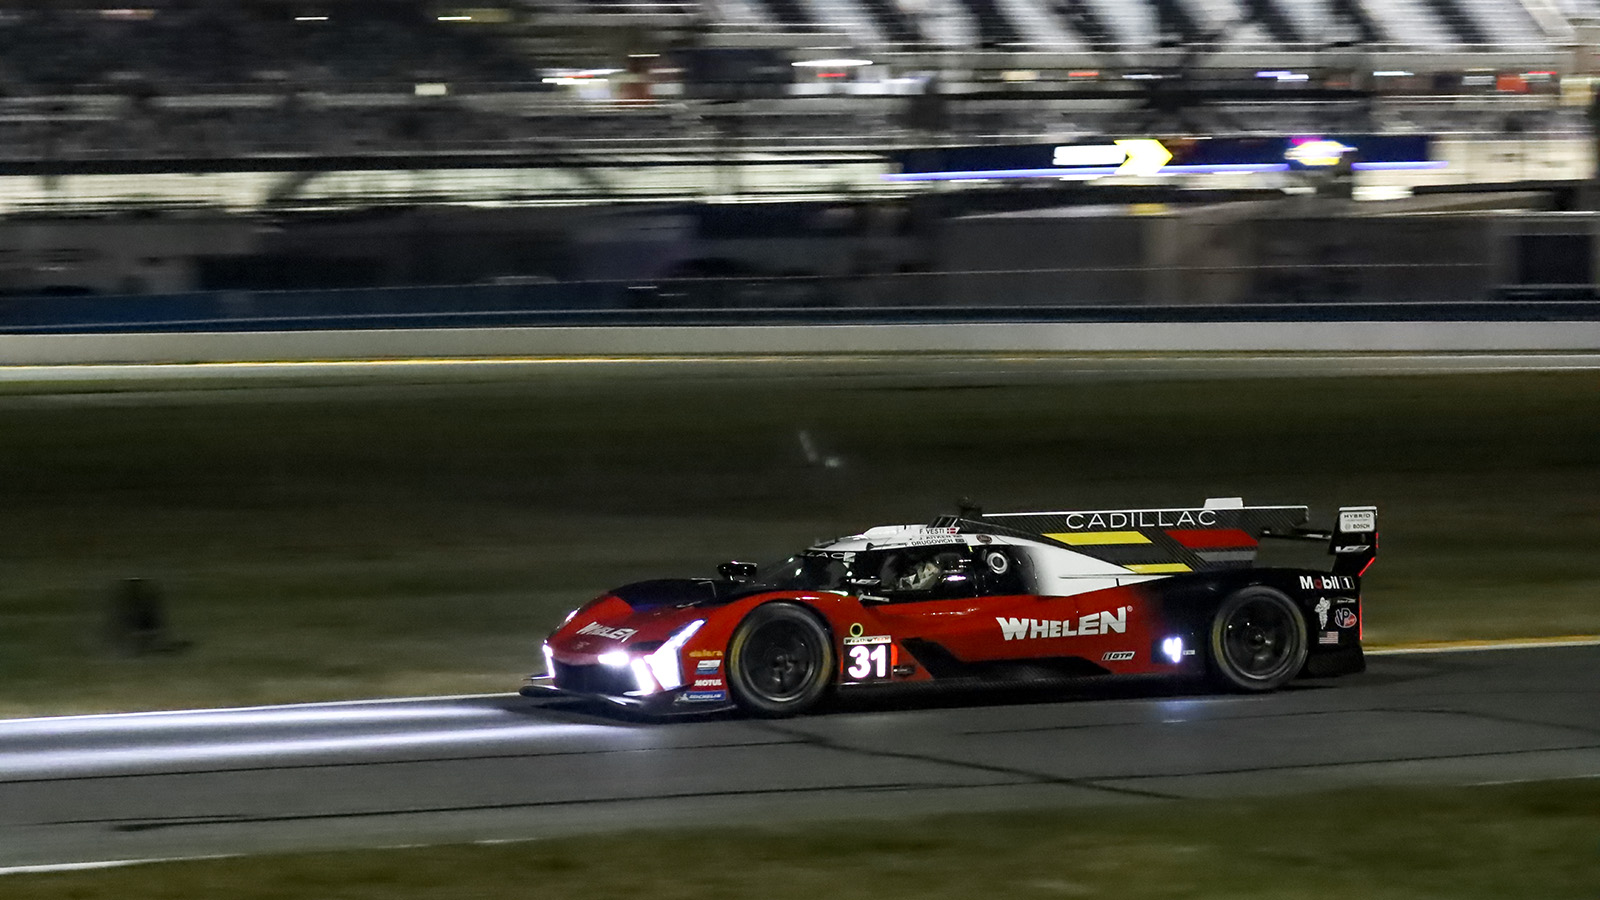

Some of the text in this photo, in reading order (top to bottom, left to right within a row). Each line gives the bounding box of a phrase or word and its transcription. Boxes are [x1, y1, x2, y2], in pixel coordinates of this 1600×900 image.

[1065, 511, 1216, 530] CADILLAC
[911, 538, 953, 547] DRUGOVICH
[1299, 575, 1340, 590] Mobil
[995, 606, 1126, 641] WHELEN
[848, 644, 887, 679] 31
[694, 679, 722, 687] MOTUL
